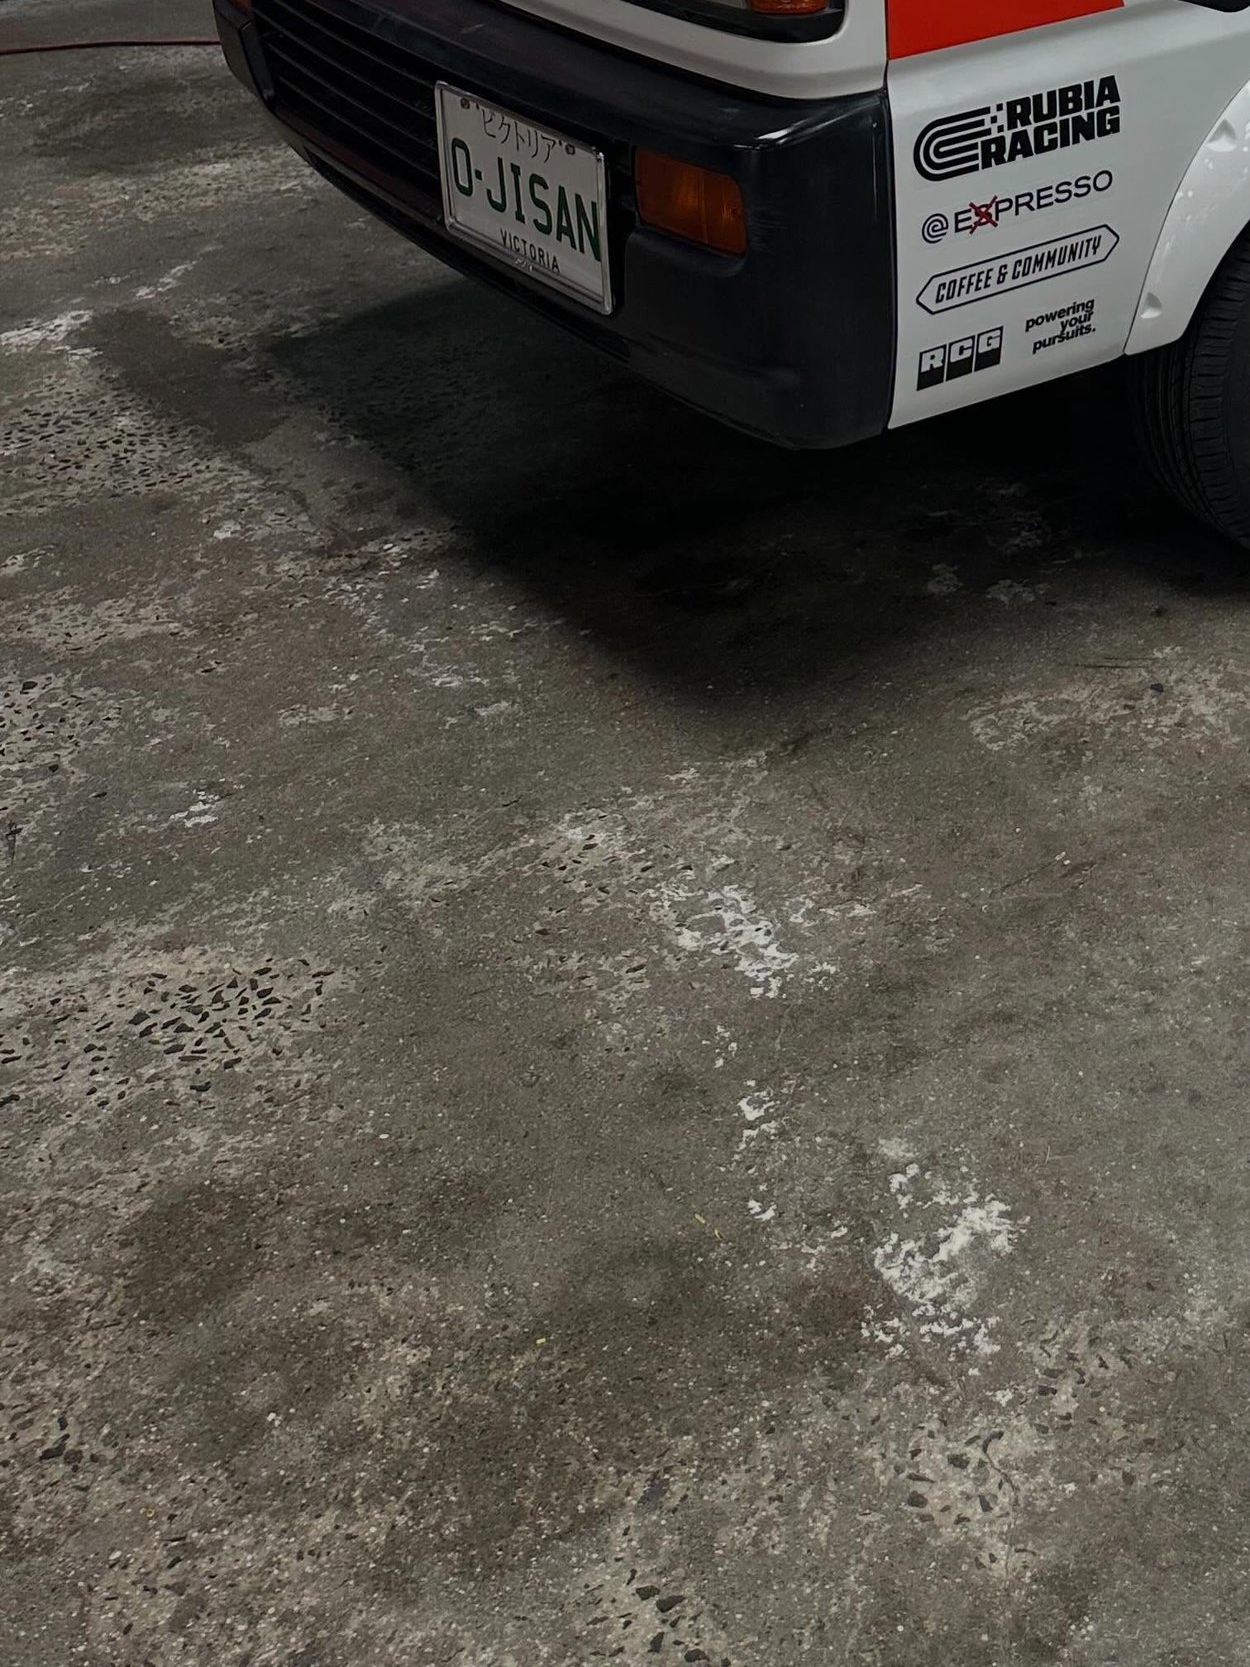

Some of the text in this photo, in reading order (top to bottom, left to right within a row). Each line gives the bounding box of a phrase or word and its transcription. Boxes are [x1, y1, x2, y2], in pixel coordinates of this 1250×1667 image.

[1005, 75, 1121, 131] RUBIA
[979, 105, 1121, 170] RACING
[500, 229, 561, 273] VICTORIA
[935, 235, 1102, 304] COFFEE & COMMUNITY
[1025, 299, 1095, 333] powering
[1060, 310, 1094, 335] your
[1033, 323, 1096, 355] pursuits.
